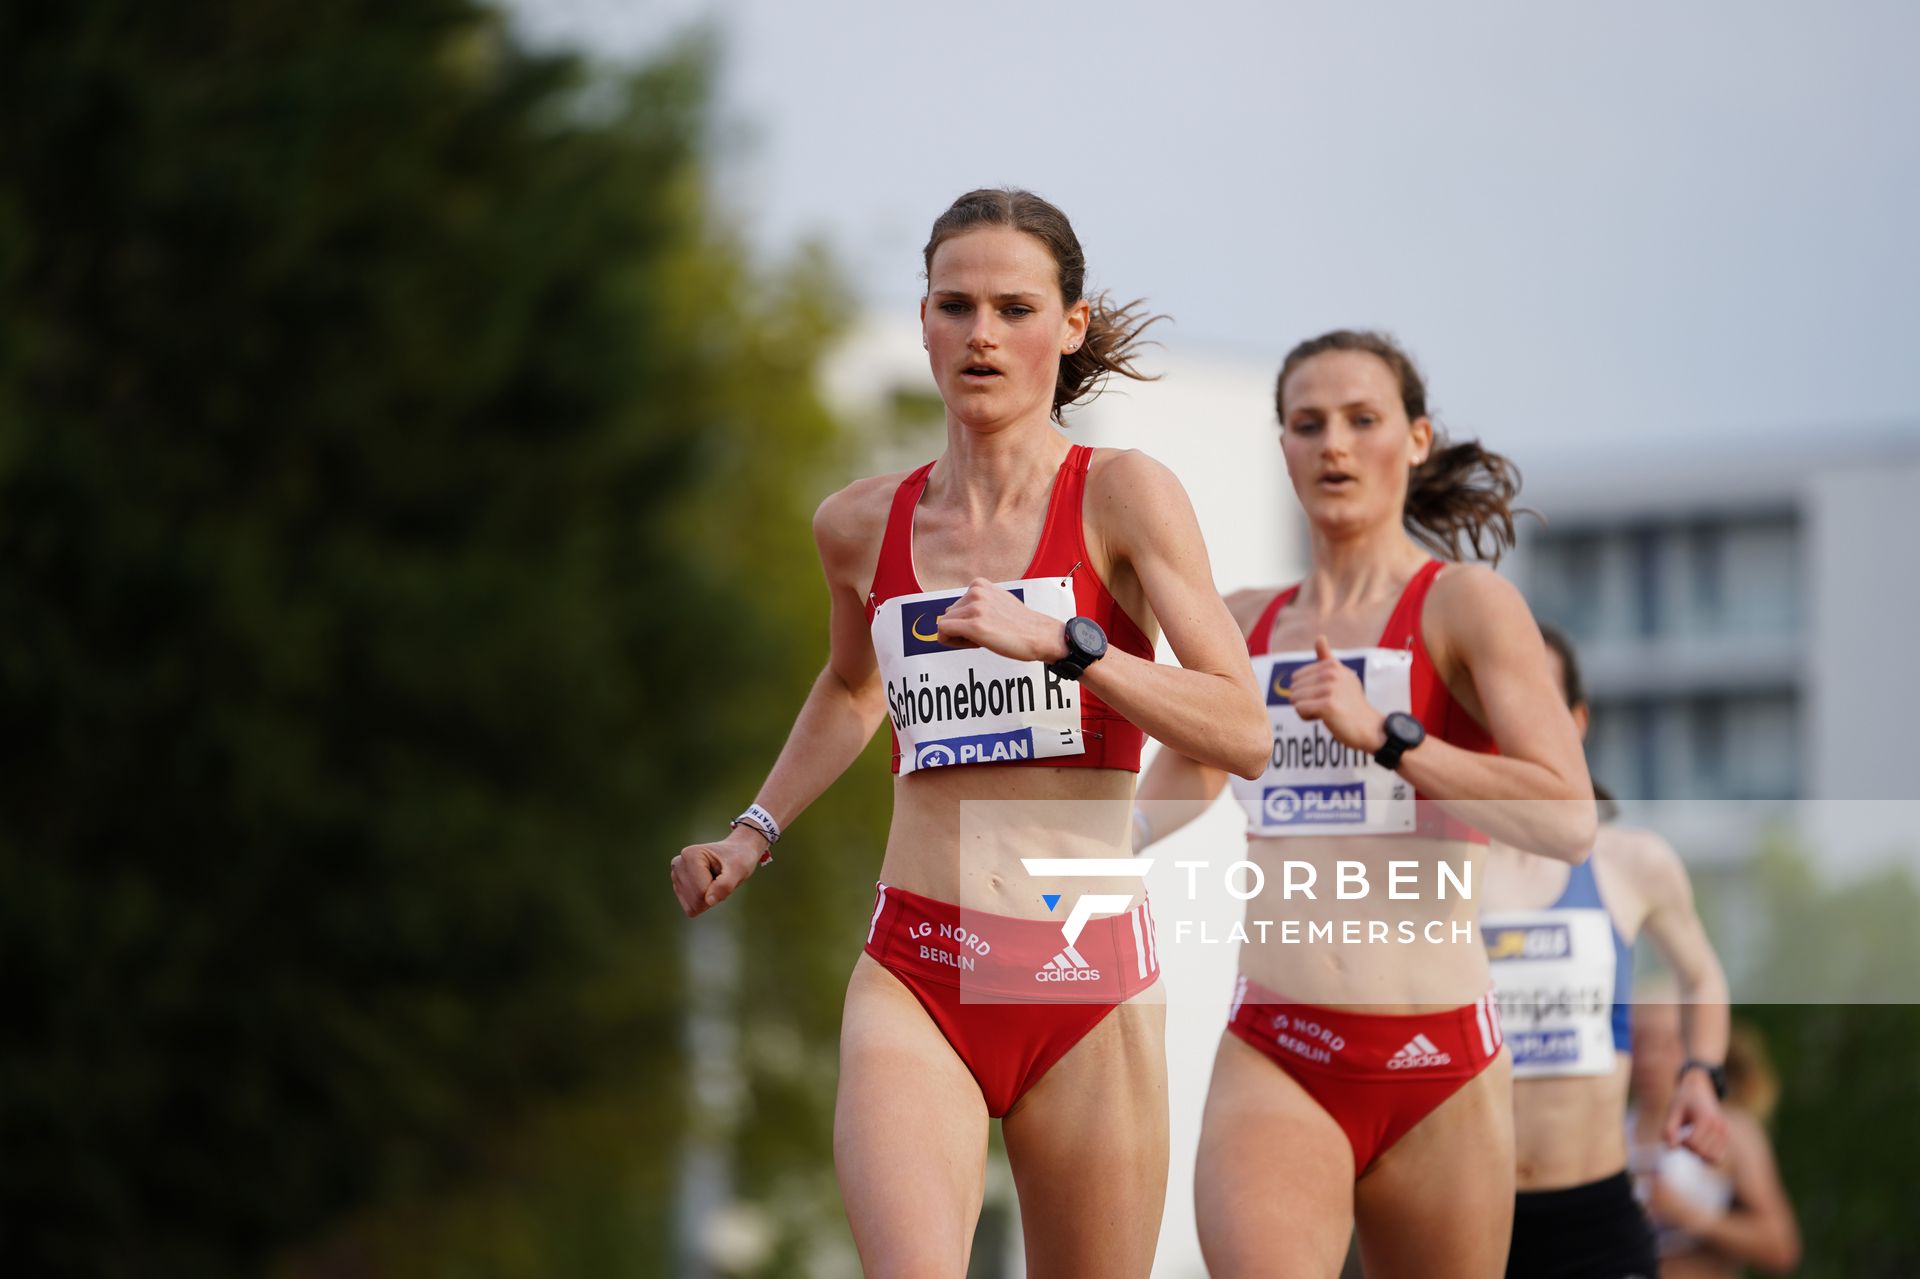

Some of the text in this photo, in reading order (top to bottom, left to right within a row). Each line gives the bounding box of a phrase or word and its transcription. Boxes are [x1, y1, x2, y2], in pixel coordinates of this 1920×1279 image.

[887, 664, 1071, 731] Schöneborn R.
[1060, 728, 1074, 745] 11
[960, 738, 1029, 762] PLAN
[1303, 789, 1362, 810] PLAN
[909, 922, 991, 956] LG NORD
[920, 945, 975, 972] BERLIN
[1035, 967, 1101, 983] adidas
[1293, 1017, 1345, 1052] NORD
[1277, 1034, 1330, 1064] BERLIN
[1386, 1052, 1452, 1070] adidas
